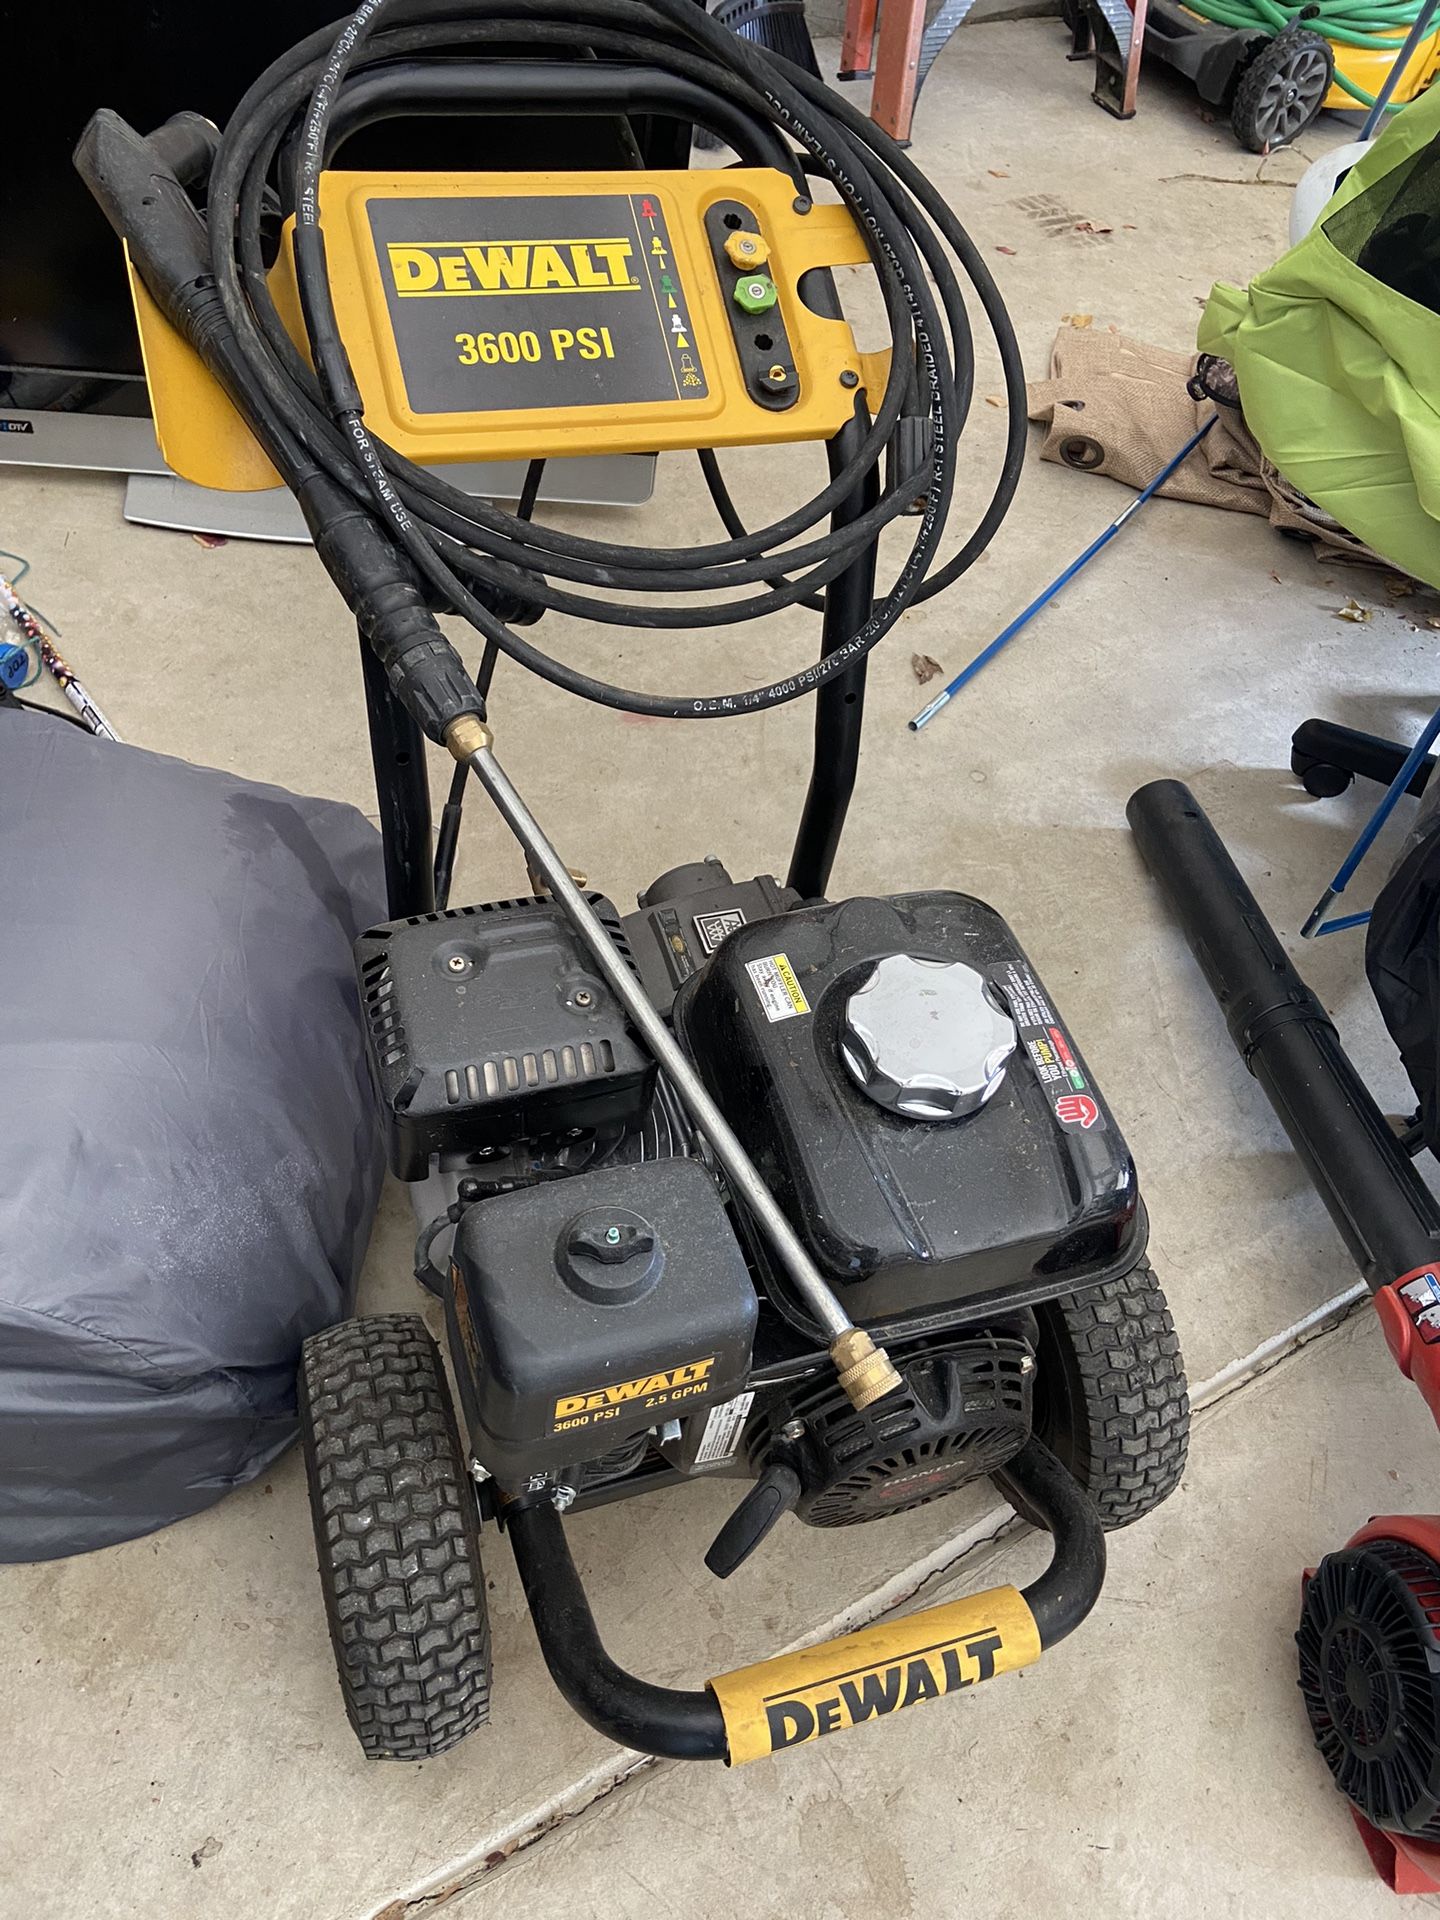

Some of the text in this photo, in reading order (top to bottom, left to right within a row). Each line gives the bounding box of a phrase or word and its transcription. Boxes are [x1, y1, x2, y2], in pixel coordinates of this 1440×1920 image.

[353, 4, 374, 25] BAR
[839, 169, 864, 204] FOR
[388, 243, 634, 291] DEWALT
[455, 326, 616, 366] 3600 PSI
[918, 330, 943, 402] BRAIDED
[933, 404, 945, 455] STEEL
[348, 419, 413, 532] FOR STEAM USE
[931, 457, 944, 483] R-1
[767, 679, 797, 699] 4000
[782, 971, 803, 1003] CAUTION
[784, 996, 794, 1008] CAN
[1027, 1040, 1053, 1083] LOOK BEFORE
[1036, 1039, 1062, 1080] YOU PUMP!
[555, 1360, 715, 1418] DEWALT
[644, 1382, 708, 1408] 2.5 GPM
[553, 1406, 620, 1432] 3600 PSI
[765, 1635, 1003, 1752] DEWALT
